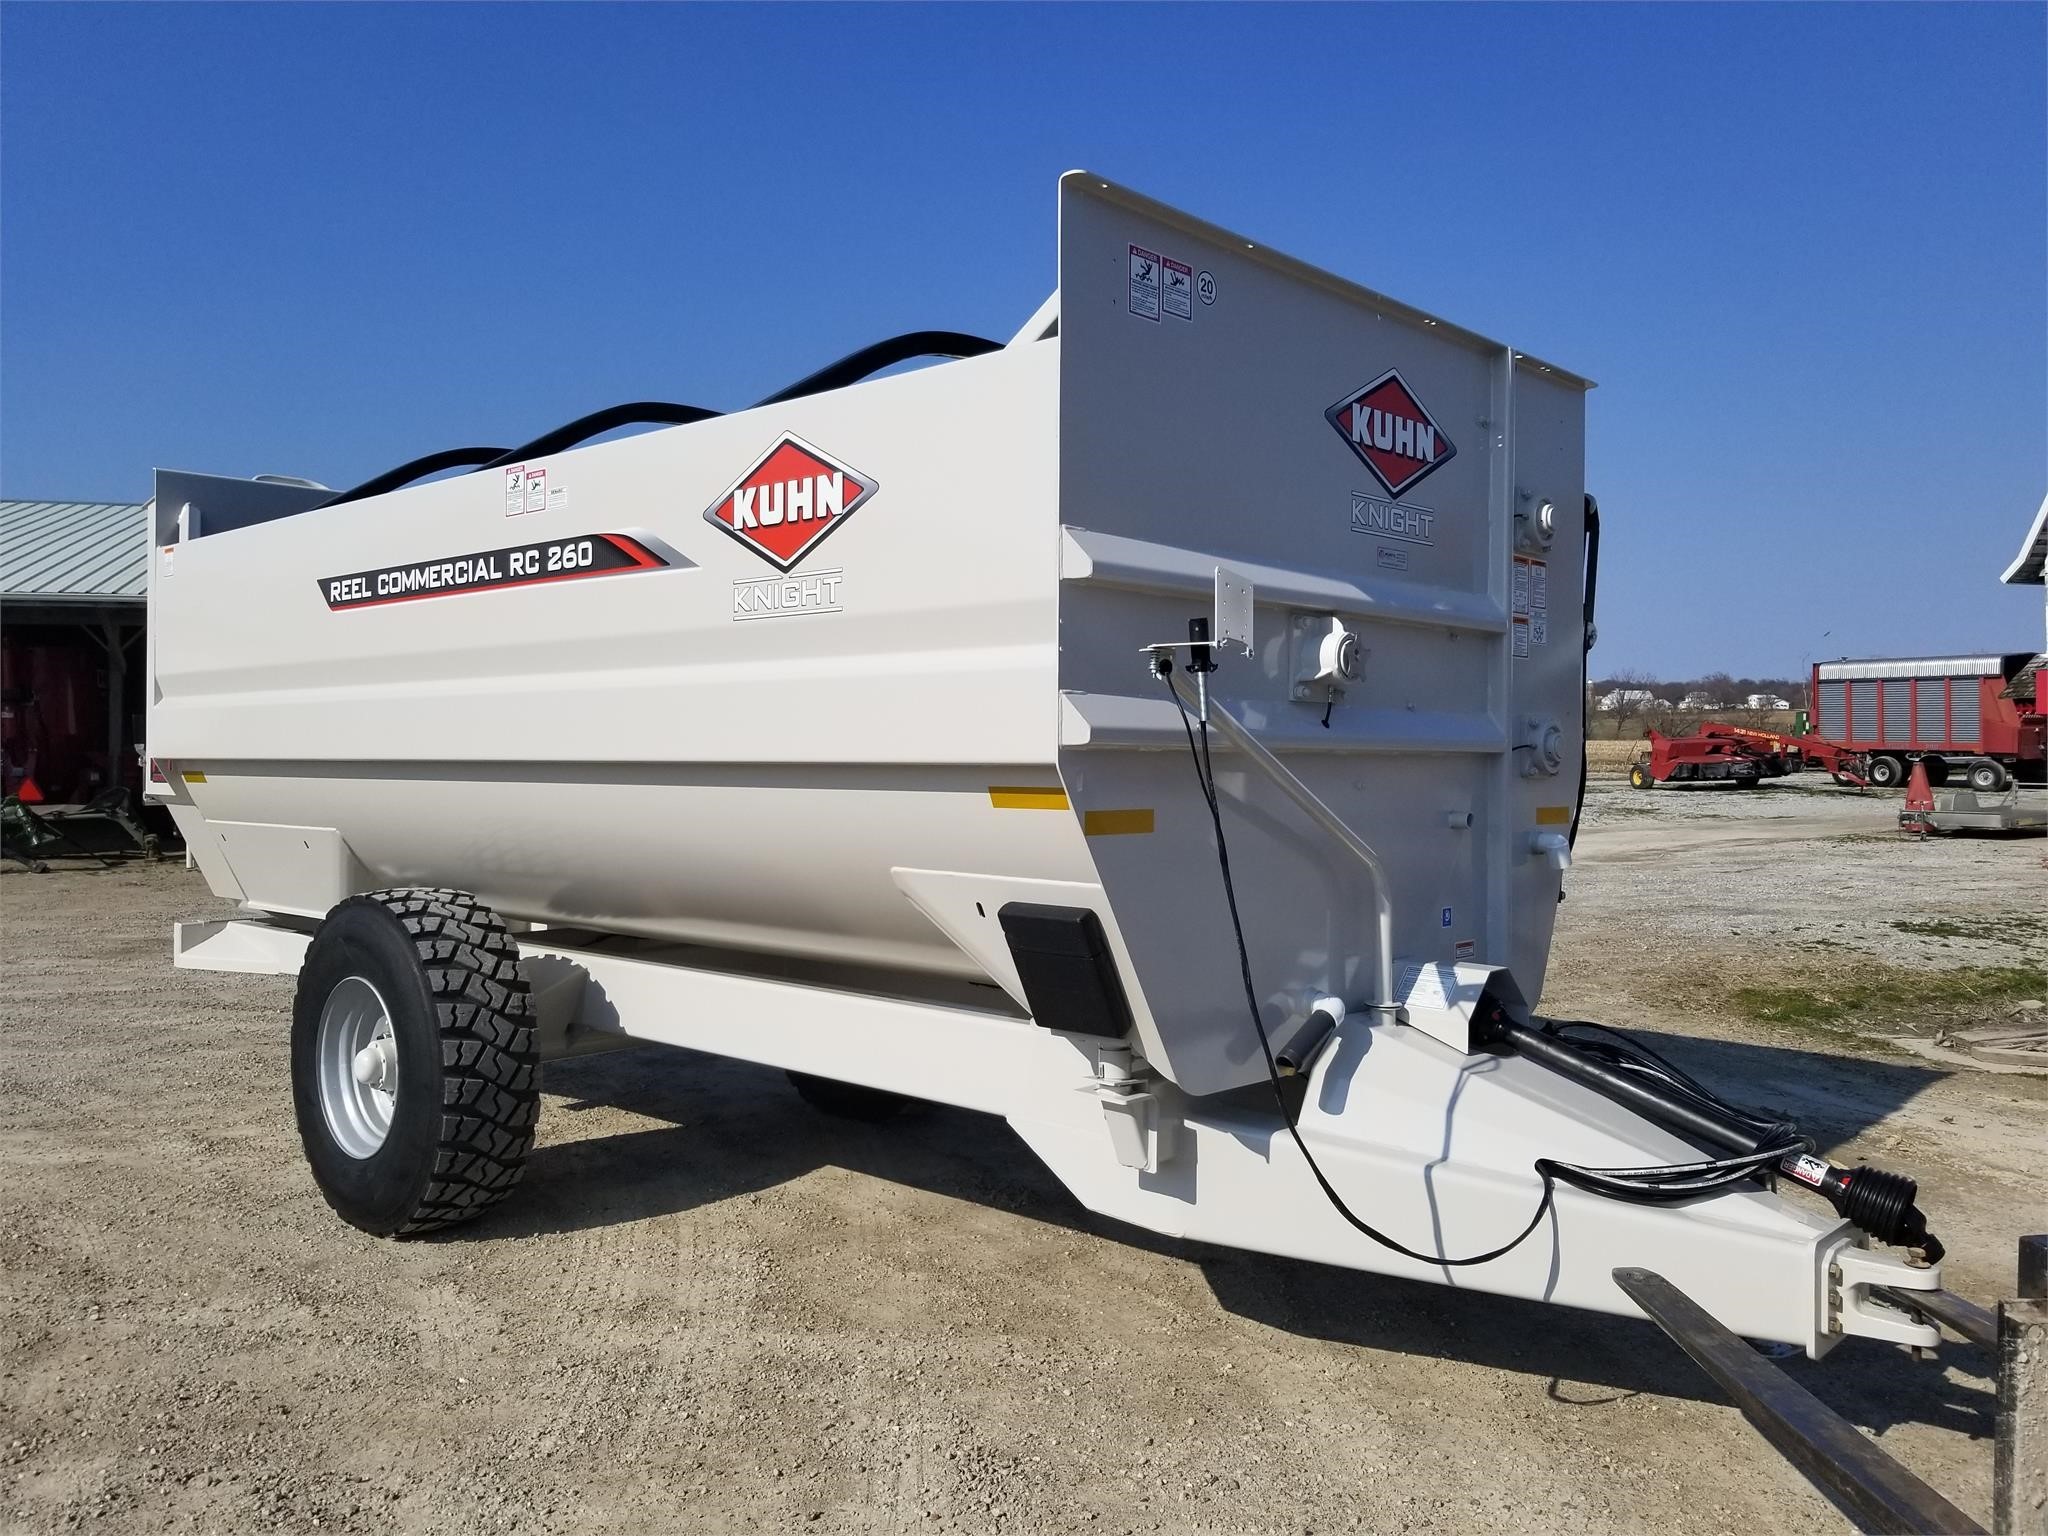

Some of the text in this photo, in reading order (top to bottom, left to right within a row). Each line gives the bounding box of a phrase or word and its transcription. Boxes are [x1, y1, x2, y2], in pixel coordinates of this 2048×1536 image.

[1200, 278, 1213, 294] 20
[1352, 402, 1435, 463] KUHN
[733, 471, 843, 531] KUHN
[1352, 499, 1434, 538] KNIGHT
[330, 541, 593, 602] REEL COMMERCIAL RC 260
[733, 576, 843, 613] KNIGHT
[1784, 1160, 1812, 1179] DANGER
